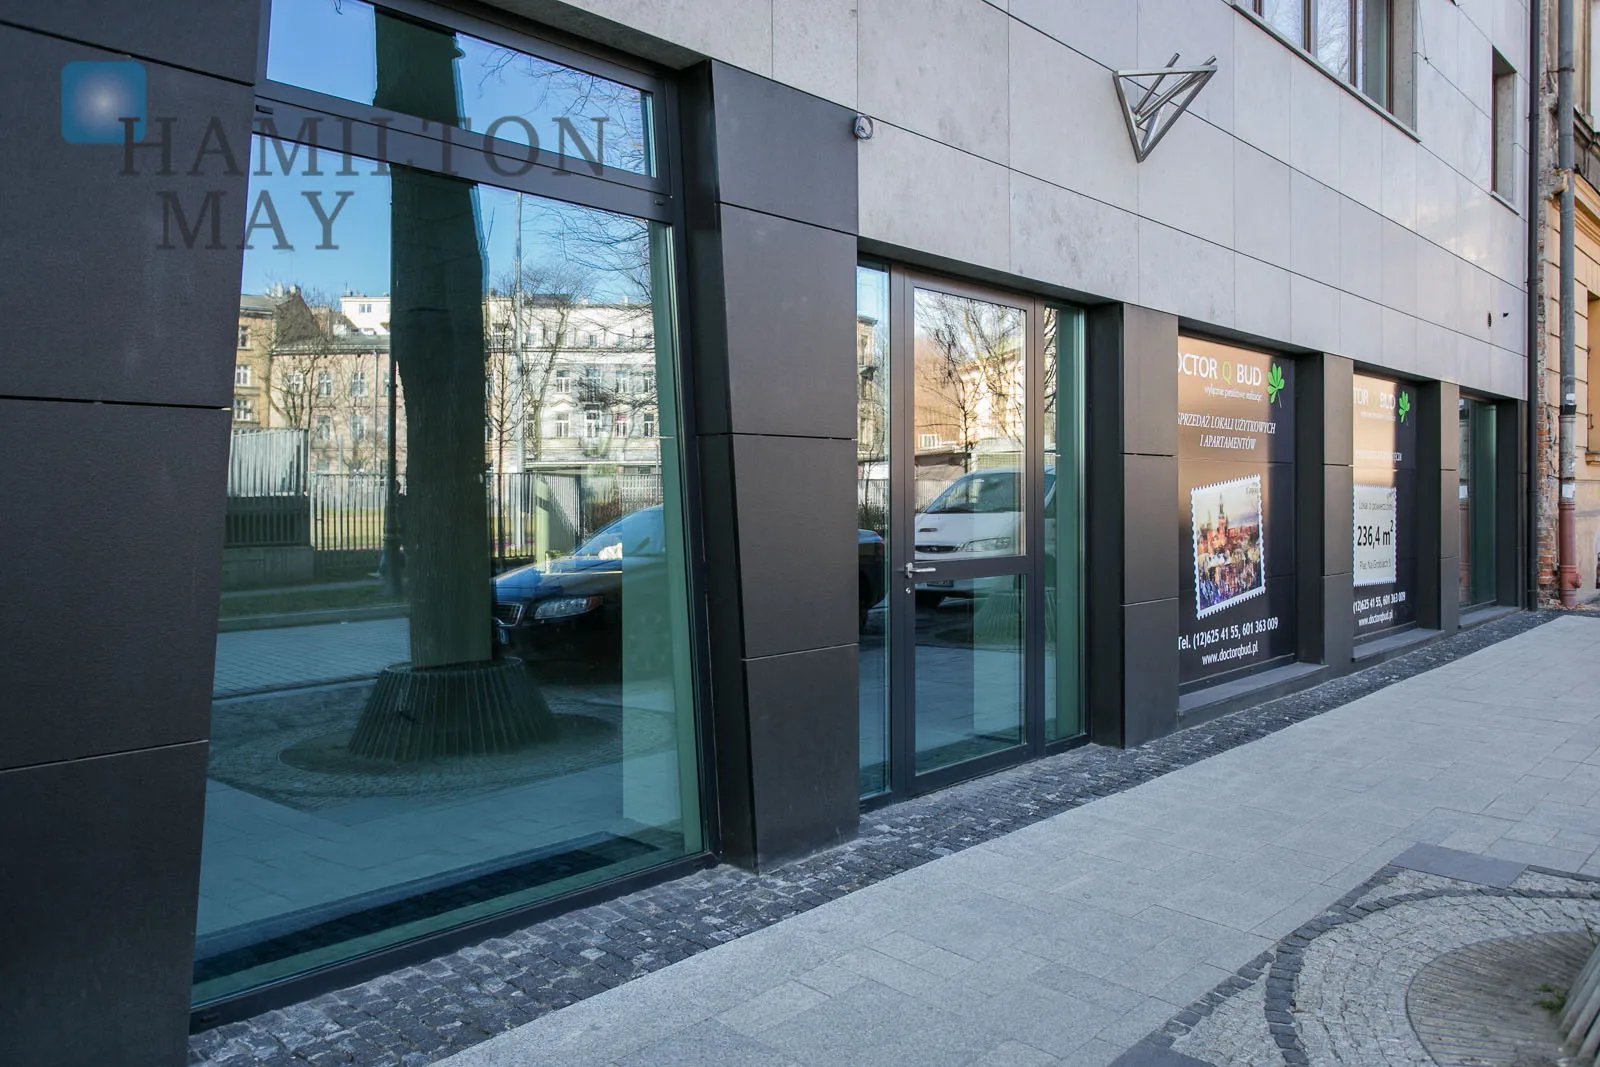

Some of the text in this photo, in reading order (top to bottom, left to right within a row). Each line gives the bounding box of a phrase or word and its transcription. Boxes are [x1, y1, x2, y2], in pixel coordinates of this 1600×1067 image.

[1222, 361, 1232, 385] Q
[1236, 364, 1262, 386] BUD
[1380, 391, 1396, 410] BUD
[1211, 415, 1235, 430] LOKALI
[1235, 417, 1276, 434] UŻYTKOWYCH
[1204, 434, 1257, 450] APARTAMENTÓW
[1357, 525, 1380, 549] 236,4
[1370, 597, 1375, 608] 41
[1178, 617, 1279, 650] Tel. (12)625 41 55, 601 363 009
[1201, 640, 1258, 666] www.doctorqbud.pl
